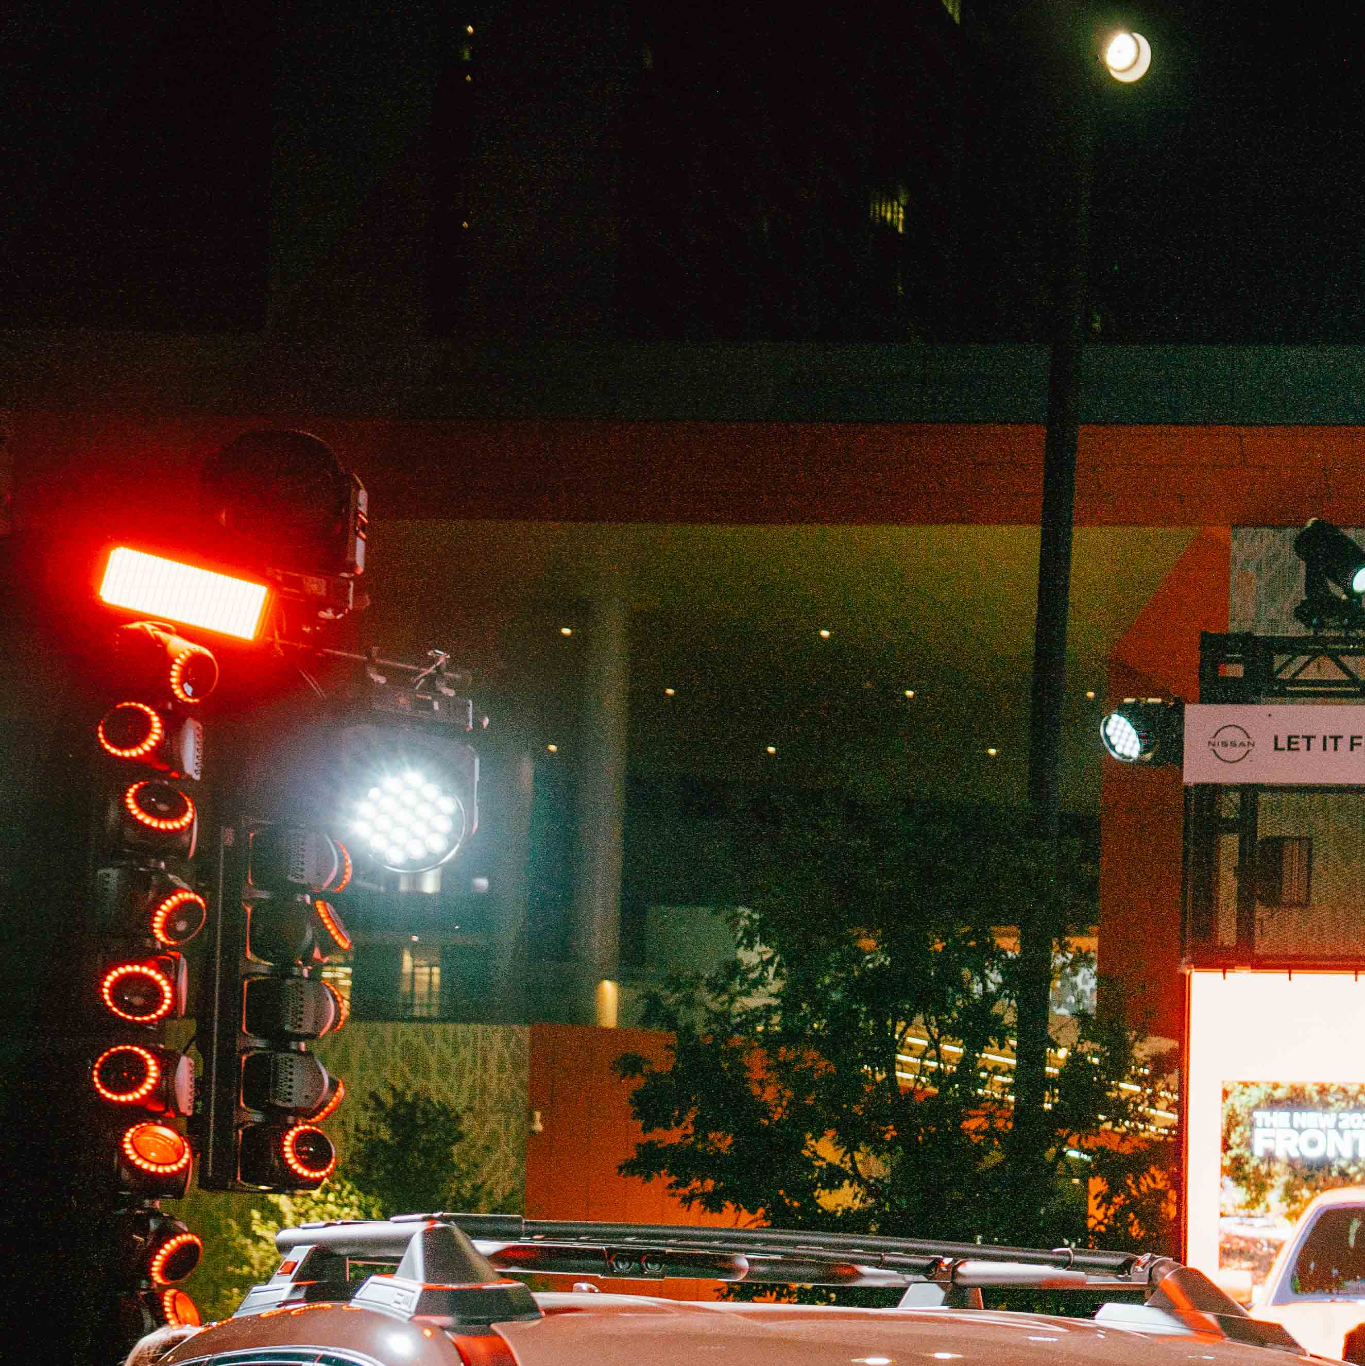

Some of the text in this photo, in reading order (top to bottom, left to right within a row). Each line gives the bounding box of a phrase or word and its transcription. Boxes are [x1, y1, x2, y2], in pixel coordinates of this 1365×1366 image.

[1207, 740, 1256, 748] NISSAN
[1273, 735, 1316, 752] LET
[1322, 735, 1343, 752] IT
[1253, 1111, 1291, 1128] THE
[1293, 1112, 1337, 1128] NEW
